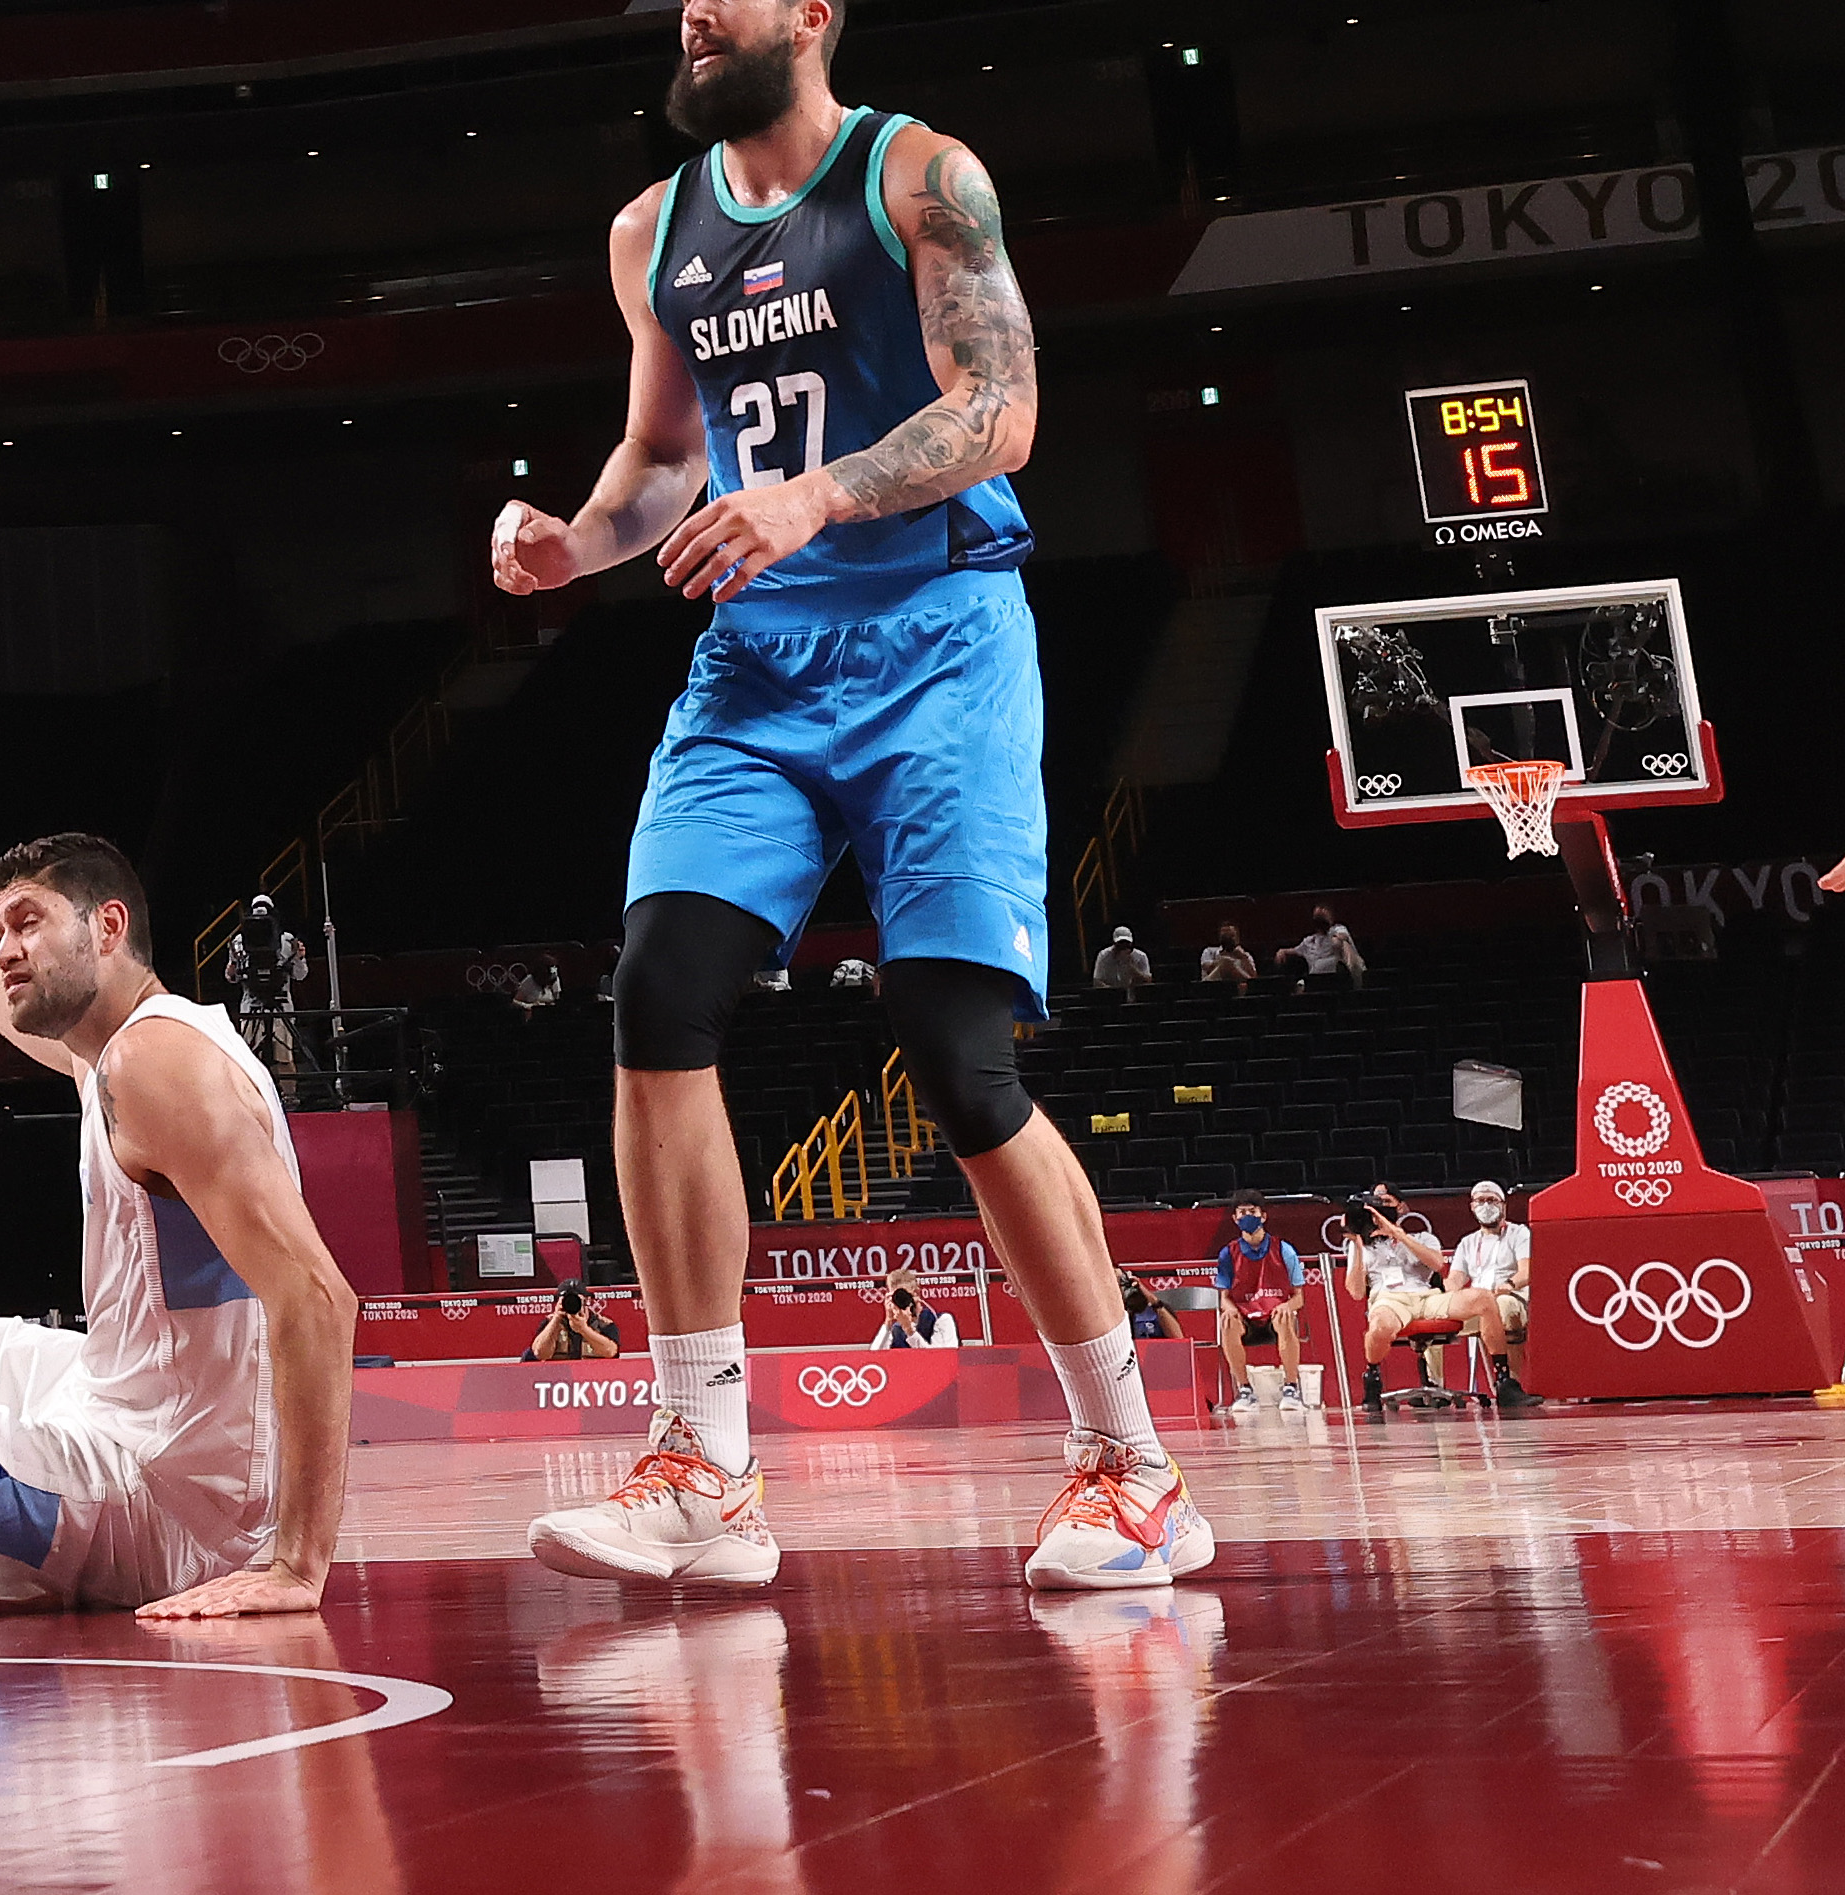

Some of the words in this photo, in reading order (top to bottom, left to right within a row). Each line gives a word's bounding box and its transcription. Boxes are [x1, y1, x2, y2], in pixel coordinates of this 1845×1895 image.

[1331, 169, 1699, 266] TOKYO
[673, 273, 714, 291] adidas
[689, 287, 839, 362] SLOVENIA
[1441, 396, 1526, 437] 8:54
[730, 370, 827, 490] 27
[1463, 441, 1530, 507] 15
[1460, 519, 1543, 542] OMEGA
[1599, 1163, 1645, 1178] TOKYO
[1648, 1161, 1683, 1175] 2020
[1794, 1241, 1820, 1251] TOKYO
[768, 1247, 889, 1279] TOKYO
[896, 1242, 986, 1273] 2020
[834, 1281, 855, 1290] TOKYO
[922, 1287, 950, 1298] OKYO
[365, 1301, 383, 1309] TOKYO
[441, 1299, 460, 1307] TOKYO
[773, 1294, 807, 1305] TOKYO
[808, 1293, 832, 1304] 2020
[362, 1310, 392, 1321] TOKYO
[394, 1309, 419, 1320] 2020
[496, 1303, 530, 1315] TOKYO
[531, 1303, 553, 1314] 2020
[535, 1380, 628, 1407] TOKYO
